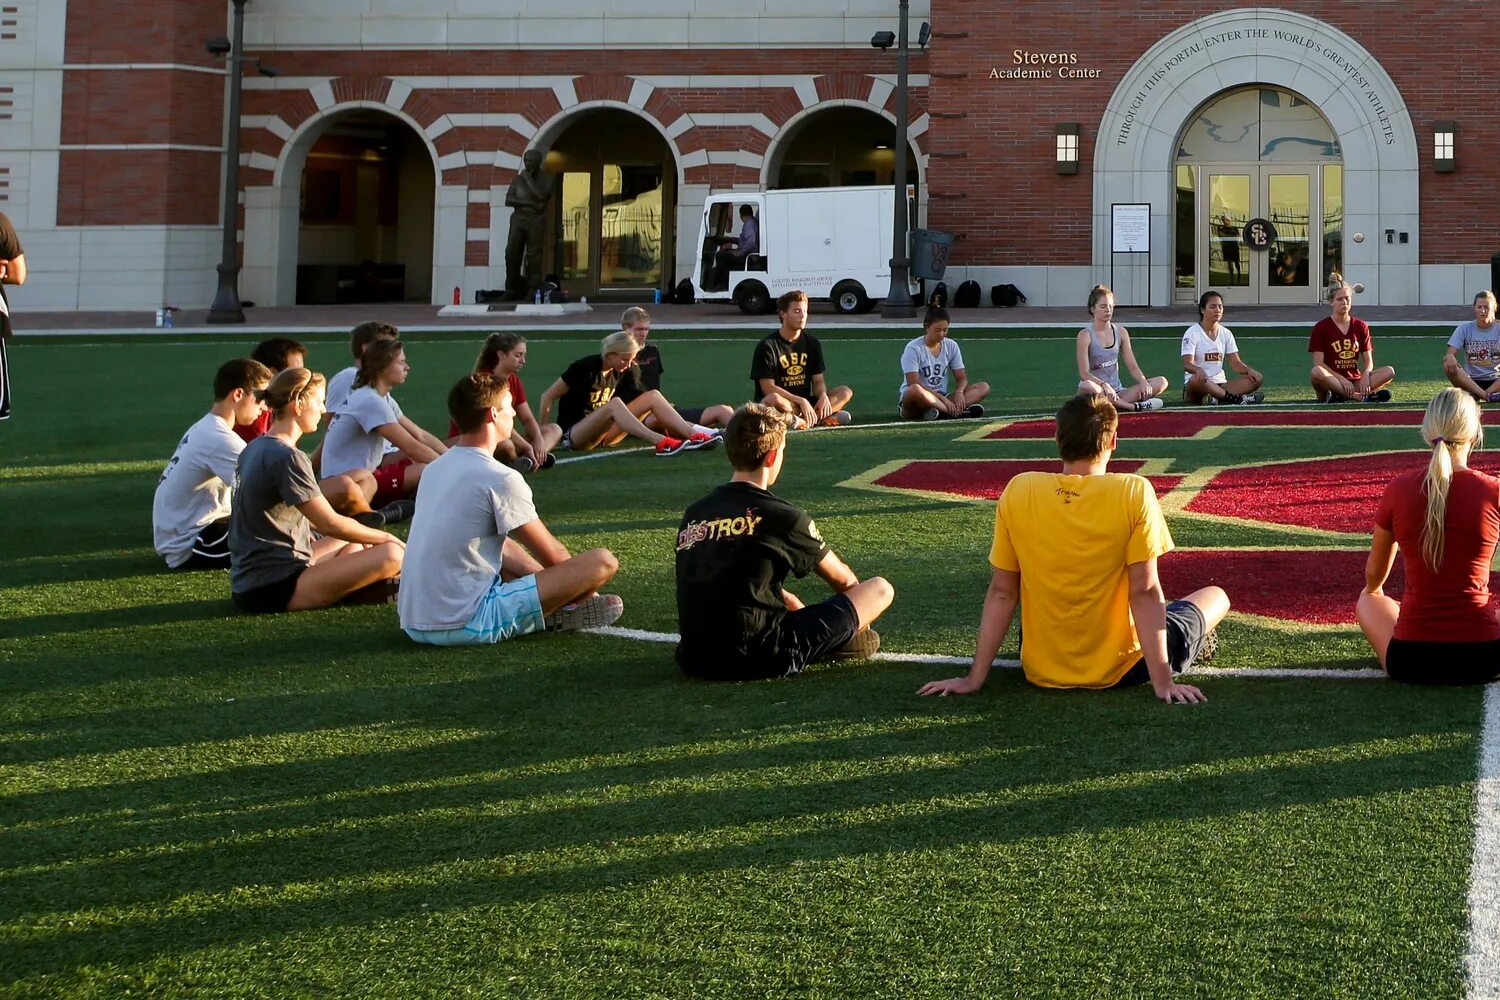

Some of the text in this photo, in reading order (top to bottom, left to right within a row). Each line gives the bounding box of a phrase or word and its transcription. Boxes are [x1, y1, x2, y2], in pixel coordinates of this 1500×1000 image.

[1013, 49, 1077, 64] Stevens
[989, 66, 1101, 79] Academic Center
[1117, 29, 1395, 146] THROUGH THIS PORTAL ENTER THE WORLD'S GREATEST ATHLETES
[780, 352, 808, 368] USC
[676, 516, 763, 551] DESTROY
